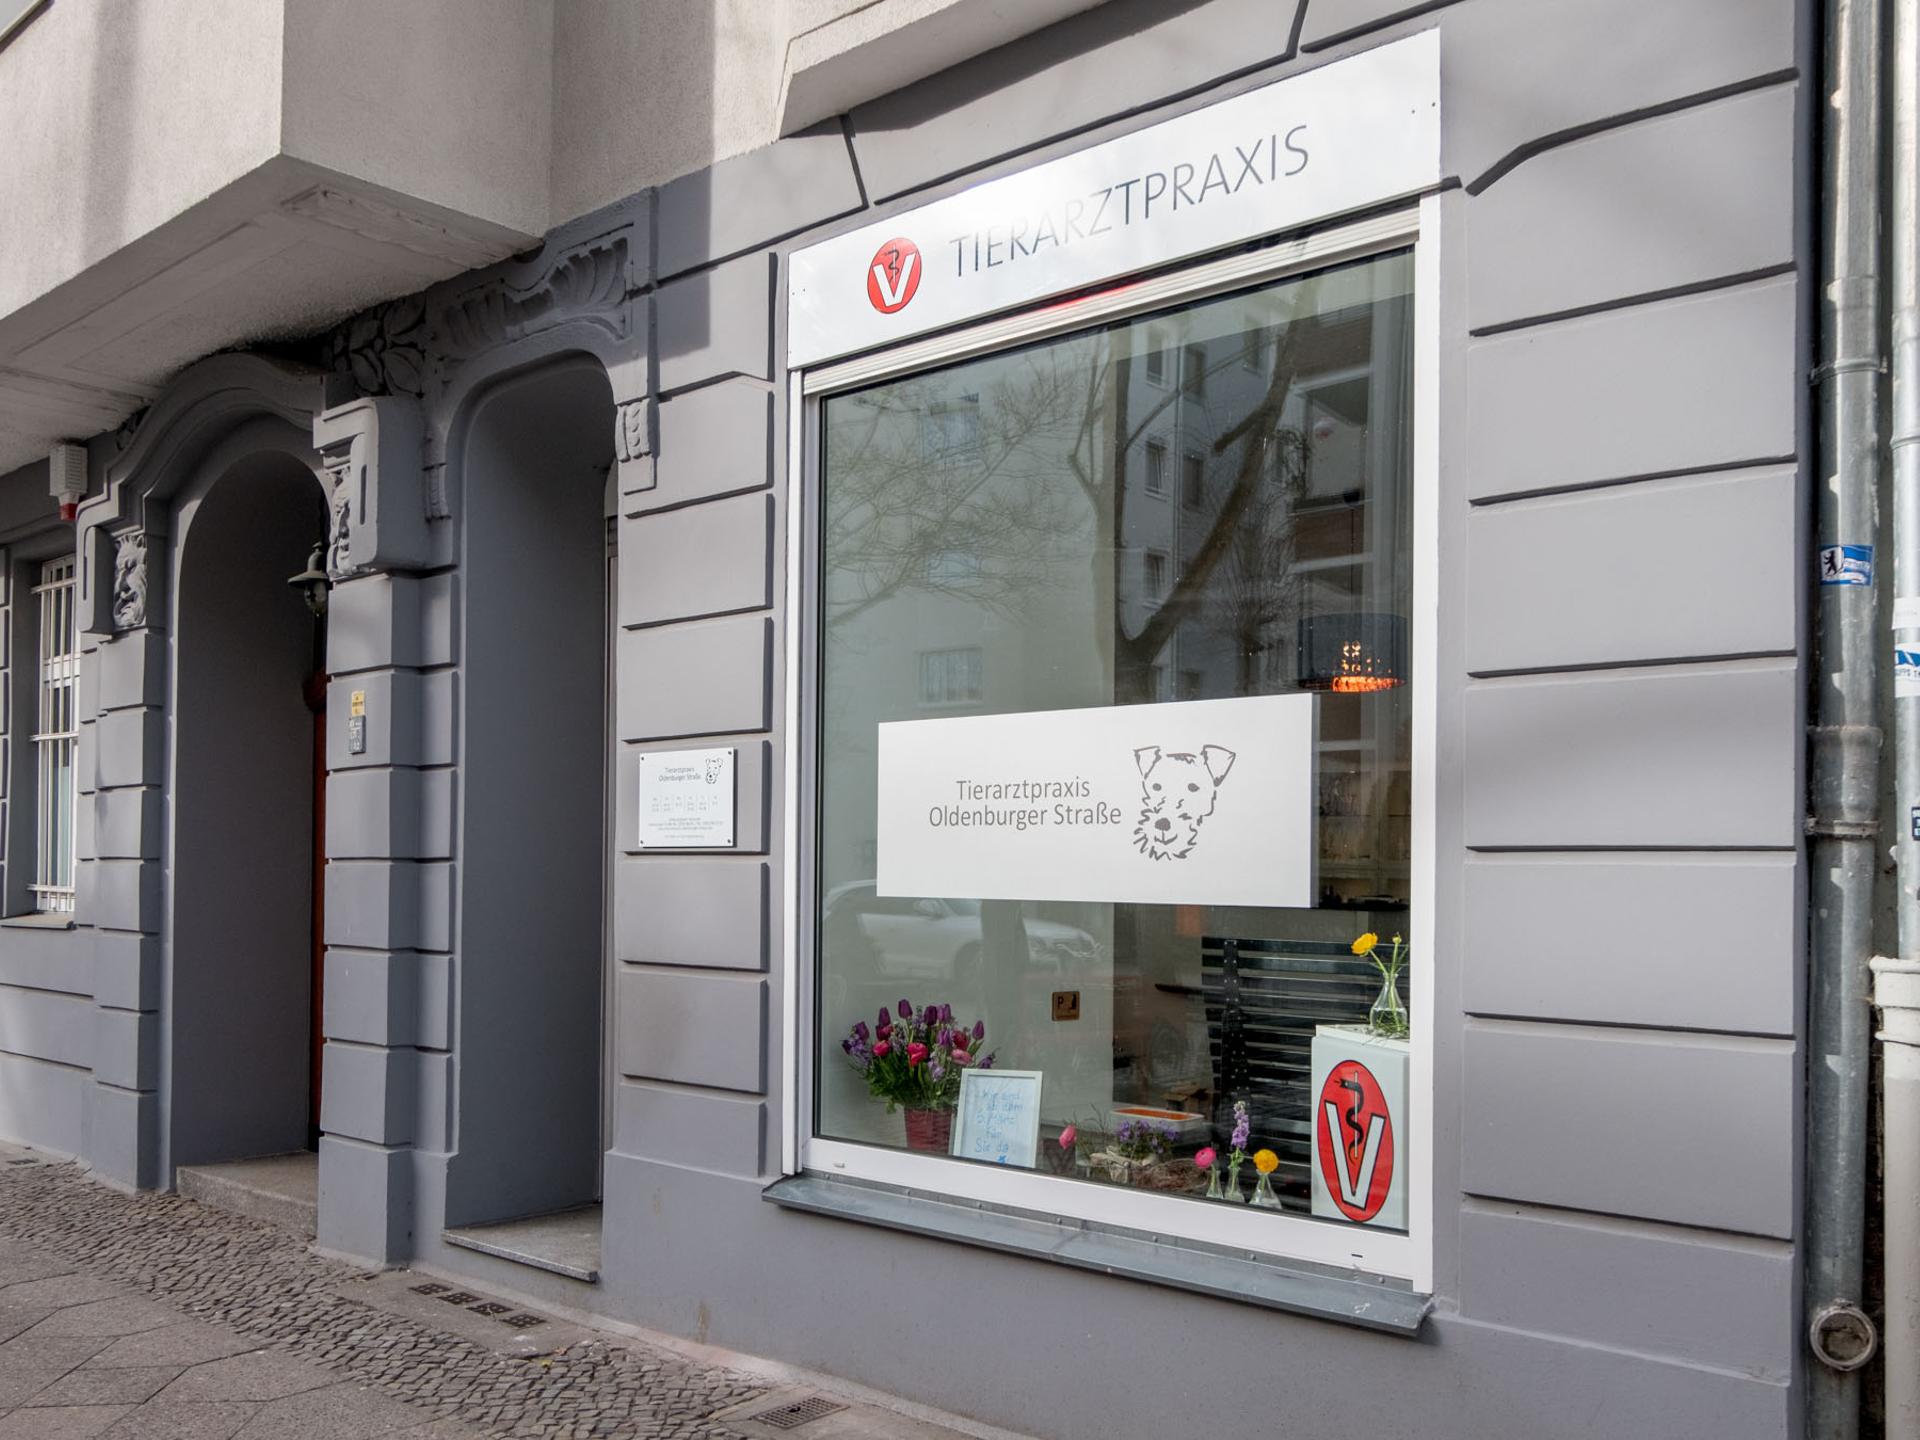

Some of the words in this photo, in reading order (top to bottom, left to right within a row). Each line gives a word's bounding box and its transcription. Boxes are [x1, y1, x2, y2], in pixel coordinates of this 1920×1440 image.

[949, 124, 1310, 277] TIERARZTPRAXIS
[956, 776, 1090, 803] Tierarztpraxis
[929, 805, 1048, 831] Oldenburger
[1053, 802, 1122, 825] Straße
